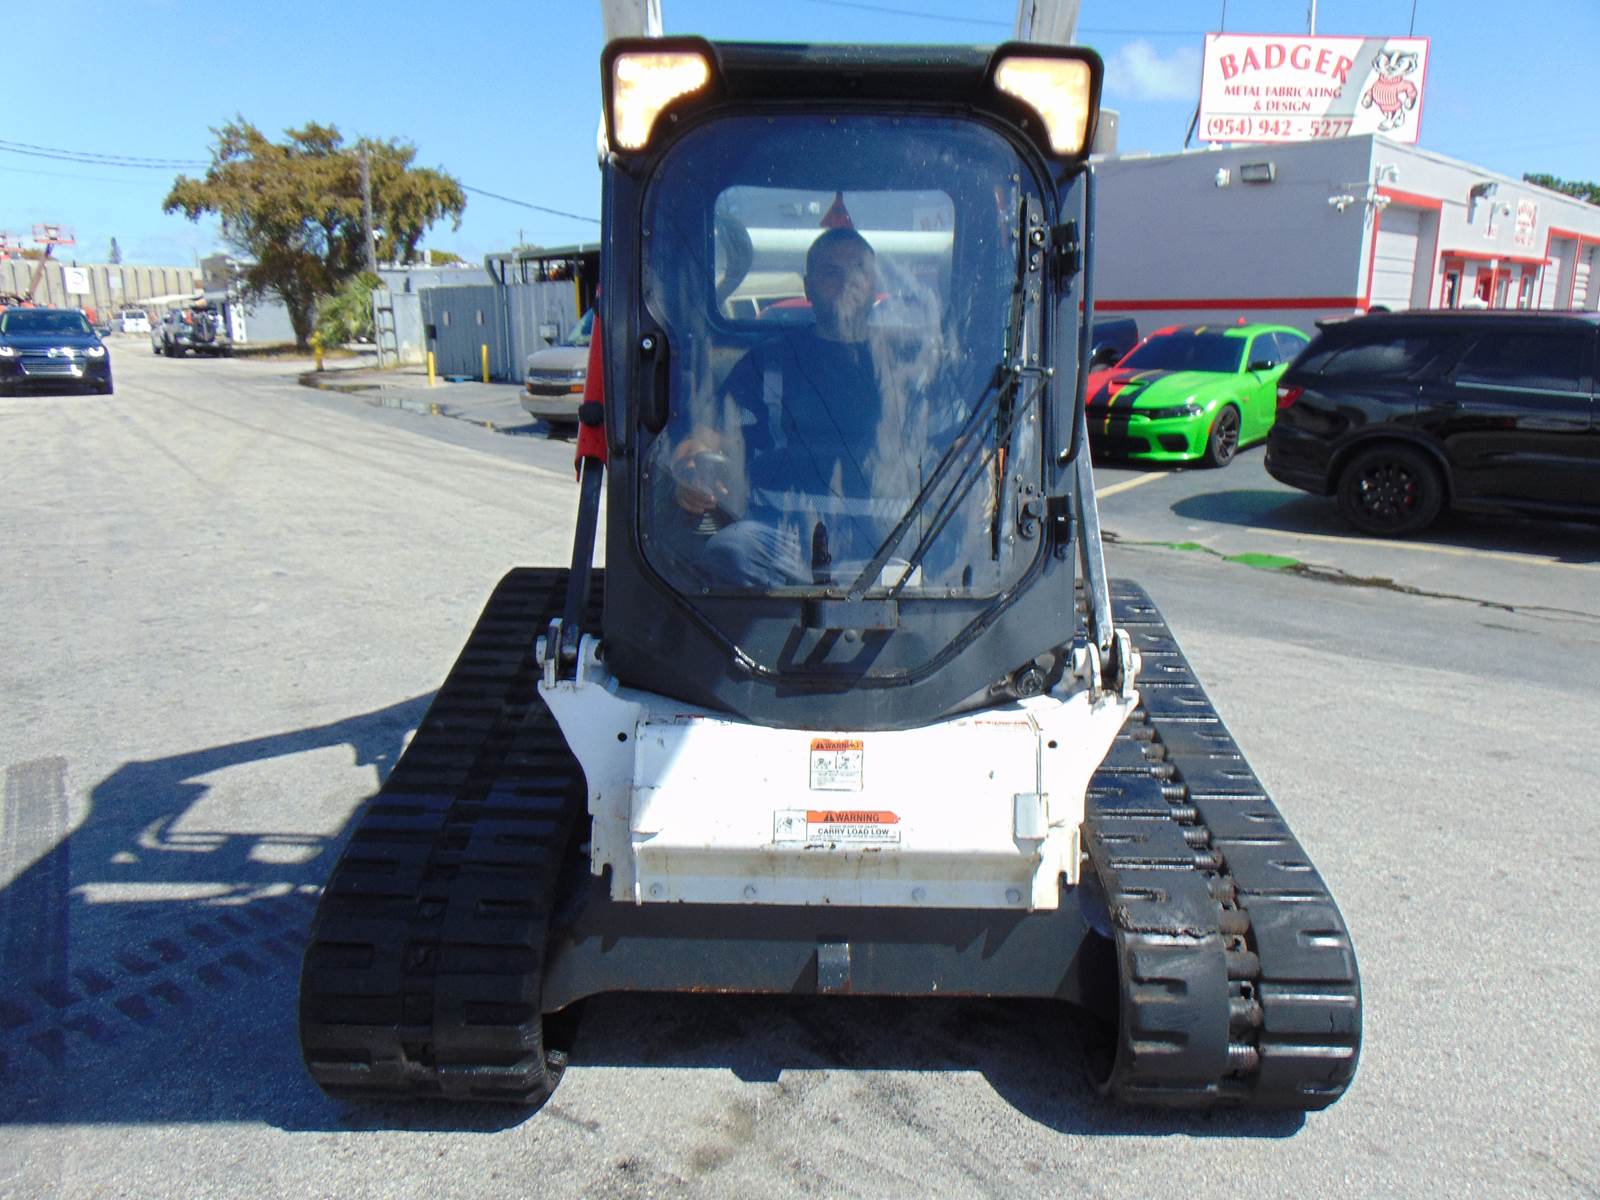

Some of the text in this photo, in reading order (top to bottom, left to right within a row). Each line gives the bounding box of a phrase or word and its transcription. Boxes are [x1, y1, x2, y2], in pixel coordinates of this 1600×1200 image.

[1219, 43, 1353, 84] BADGER
[1224, 85, 1342, 98] METAL FABRICATING
[1253, 101, 1311, 112] & DESIGN
[1207, 117, 1252, 136] (954)
[1259, 118, 1291, 136] 942
[1310, 119, 1353, 137] 5277
[835, 813, 880, 822] WARNING
